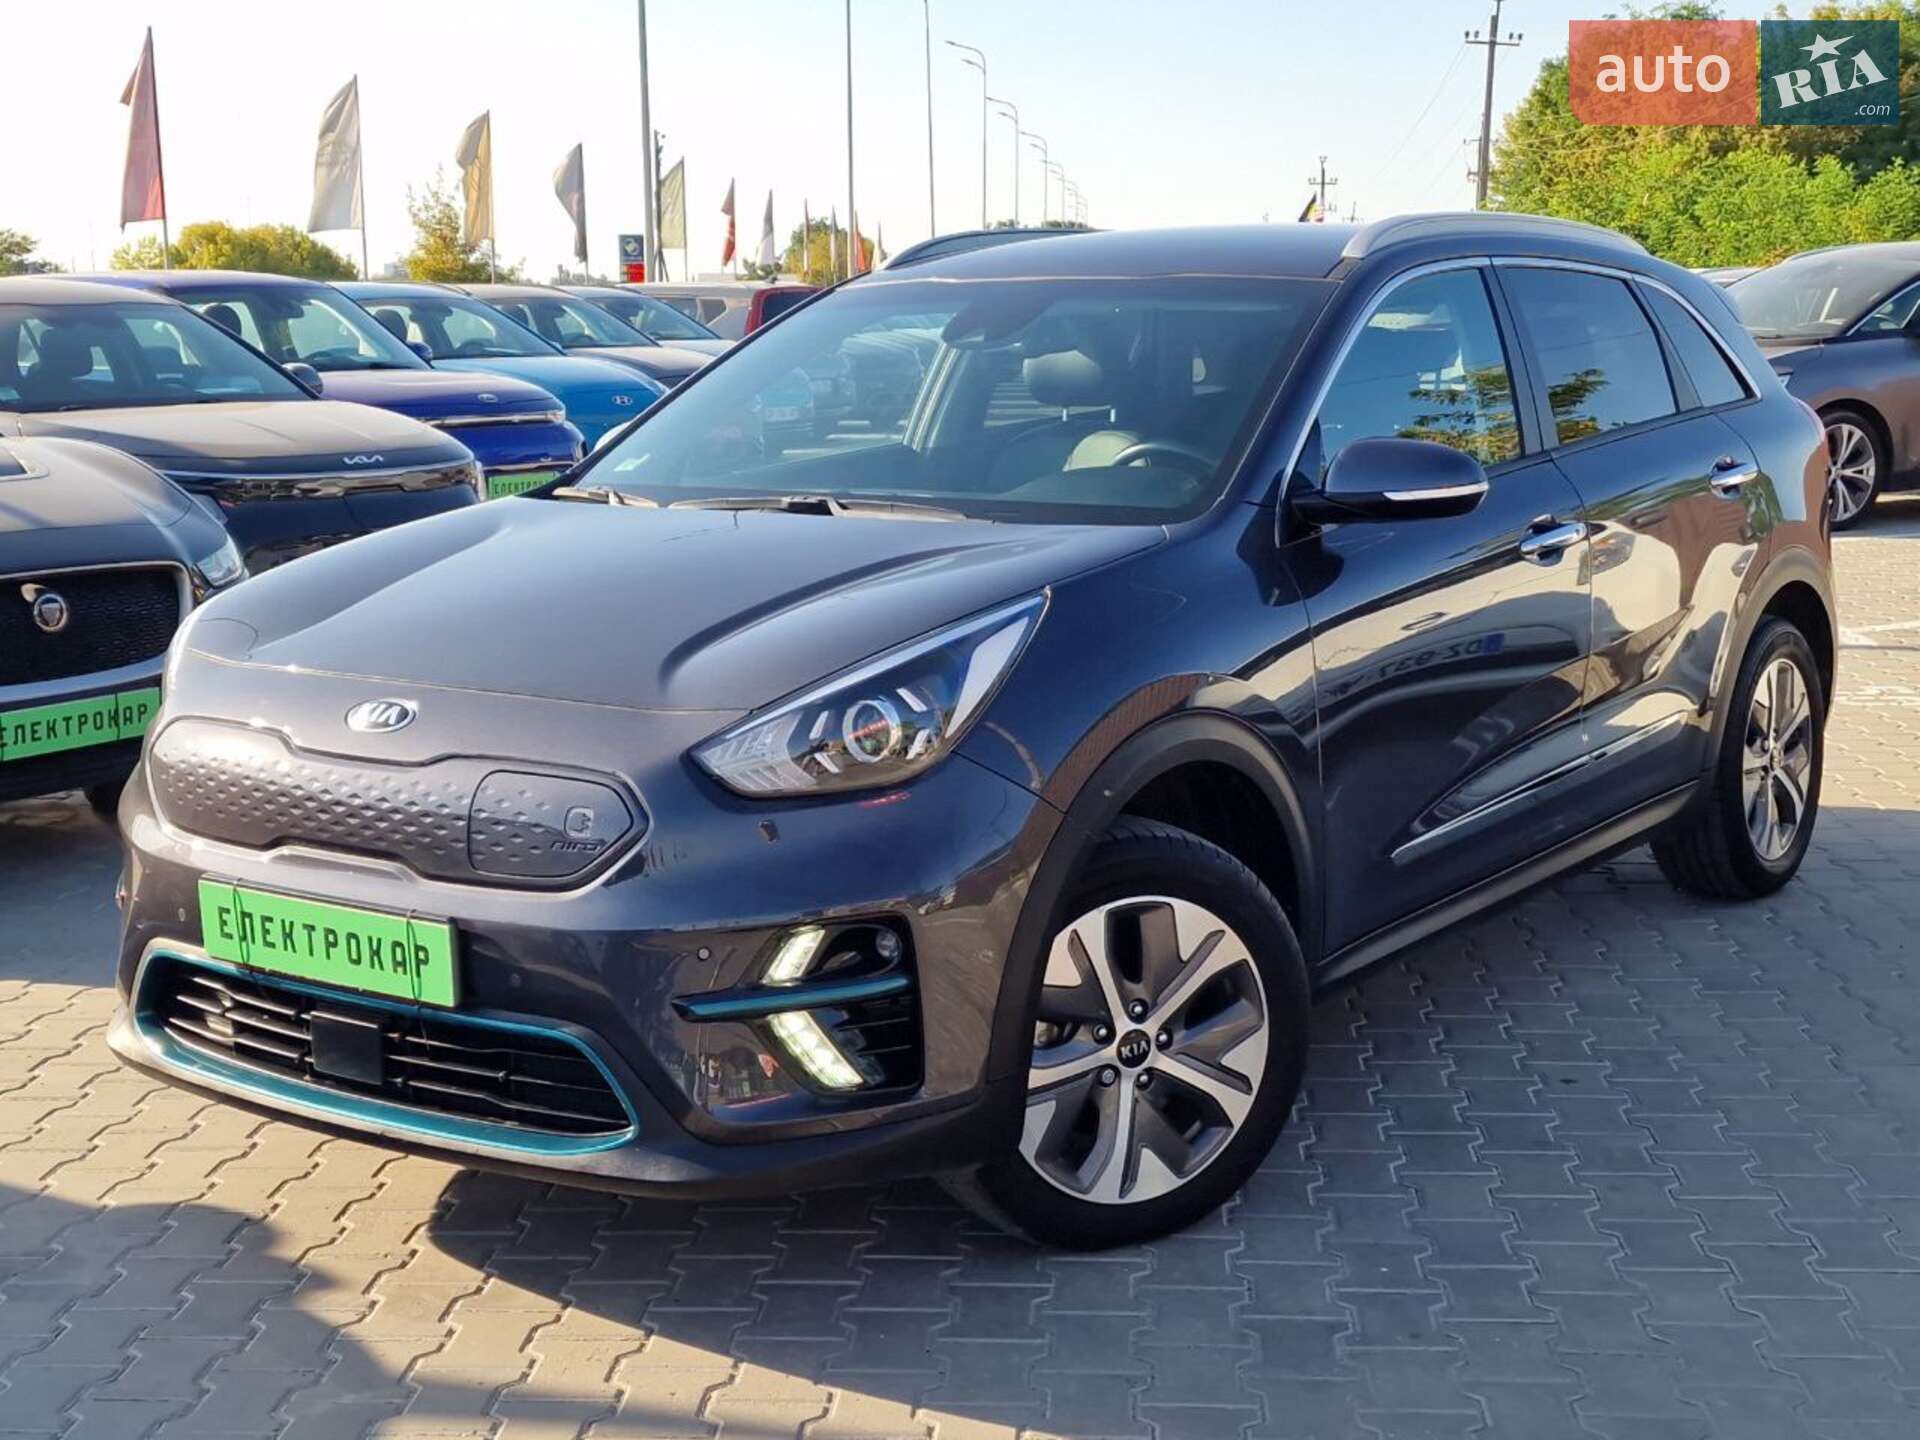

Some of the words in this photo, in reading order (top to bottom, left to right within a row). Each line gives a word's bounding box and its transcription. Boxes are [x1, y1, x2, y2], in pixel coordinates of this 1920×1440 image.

[0, 702, 149, 748] ЕЛЕКТРОКАР
[217, 905, 430, 978] ЕЛЕКТРОКАР
[1120, 1040, 1149, 1058] KIA
